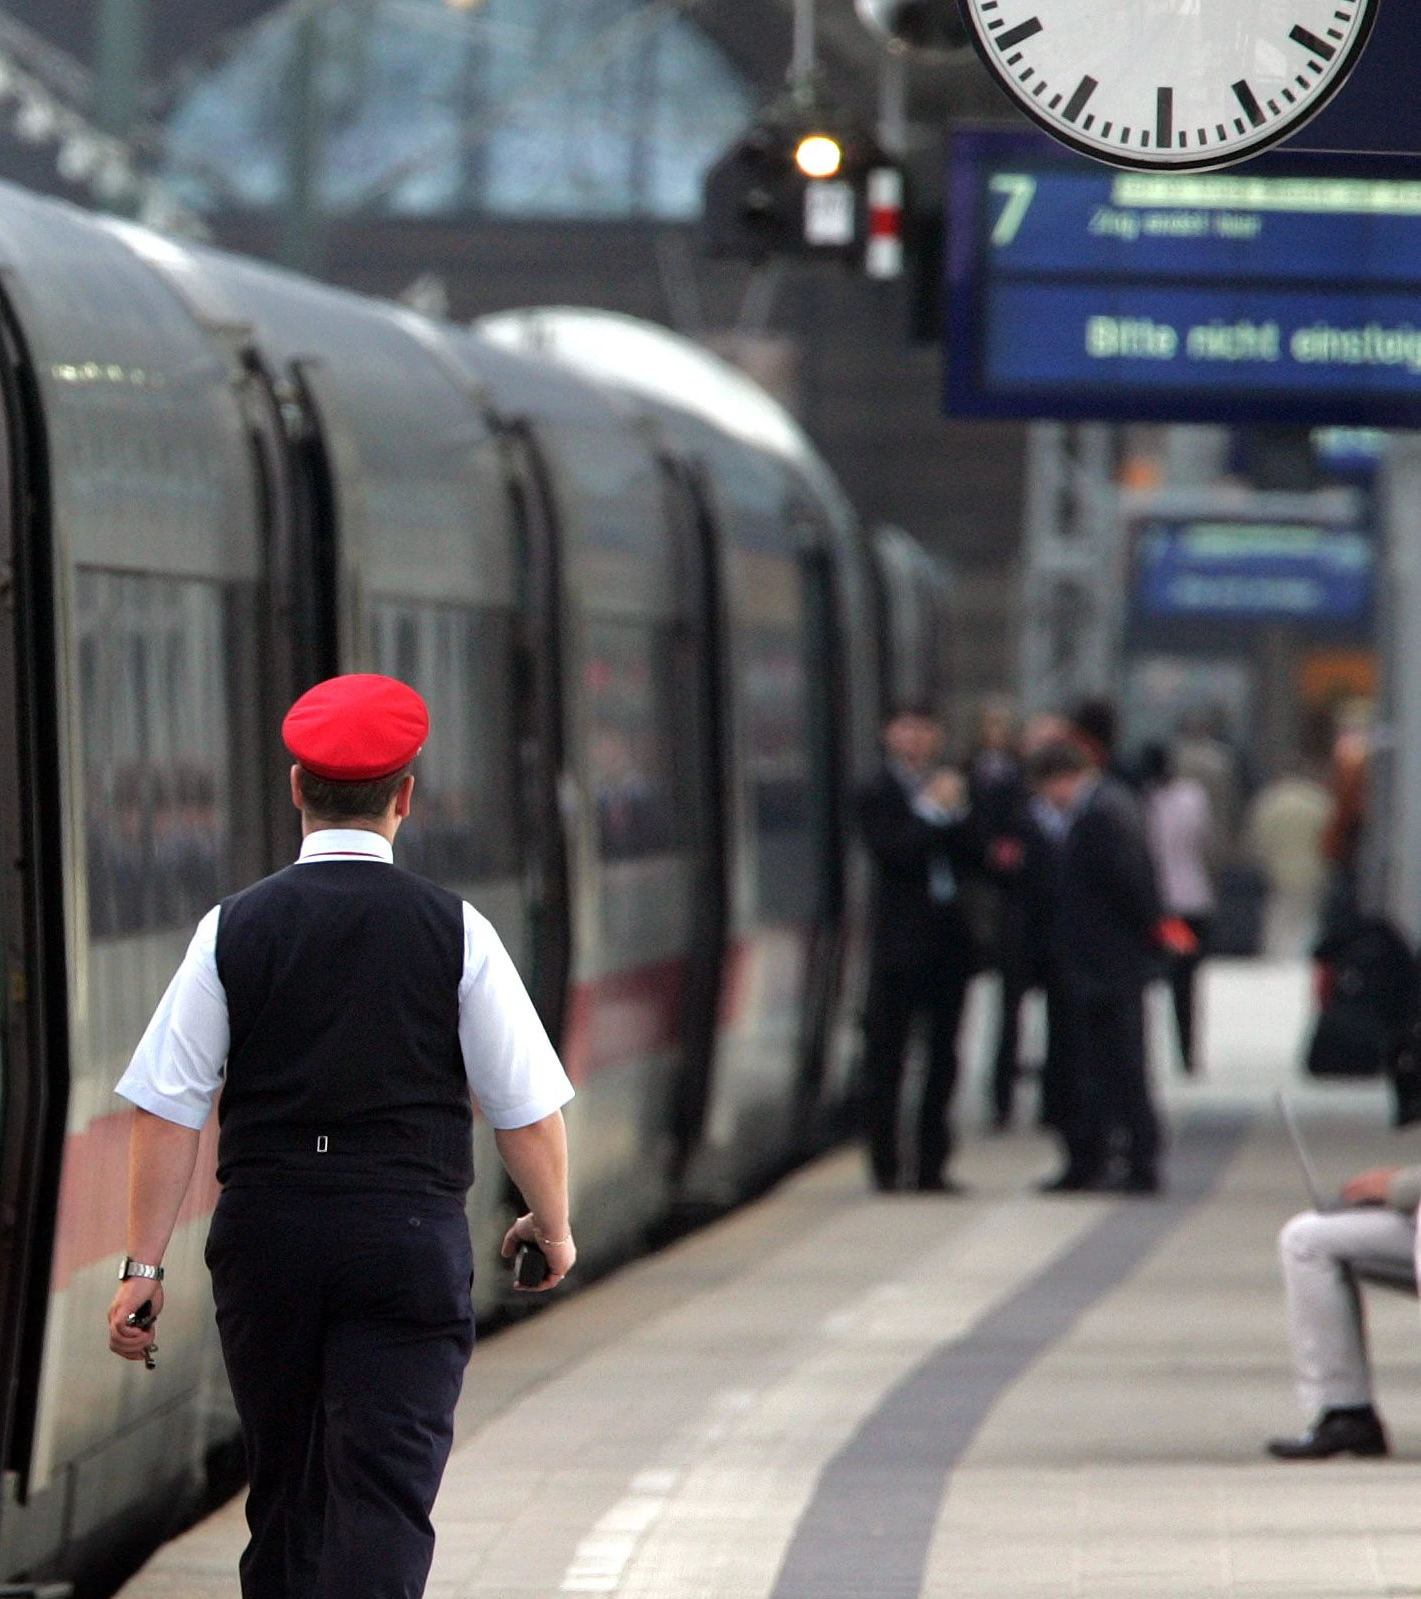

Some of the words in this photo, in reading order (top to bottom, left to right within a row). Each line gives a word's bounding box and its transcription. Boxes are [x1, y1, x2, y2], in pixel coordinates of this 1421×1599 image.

[988, 172, 1037, 247] 7
[1085, 315, 1178, 359] Bitte
[1186, 319, 1280, 362] nicht
